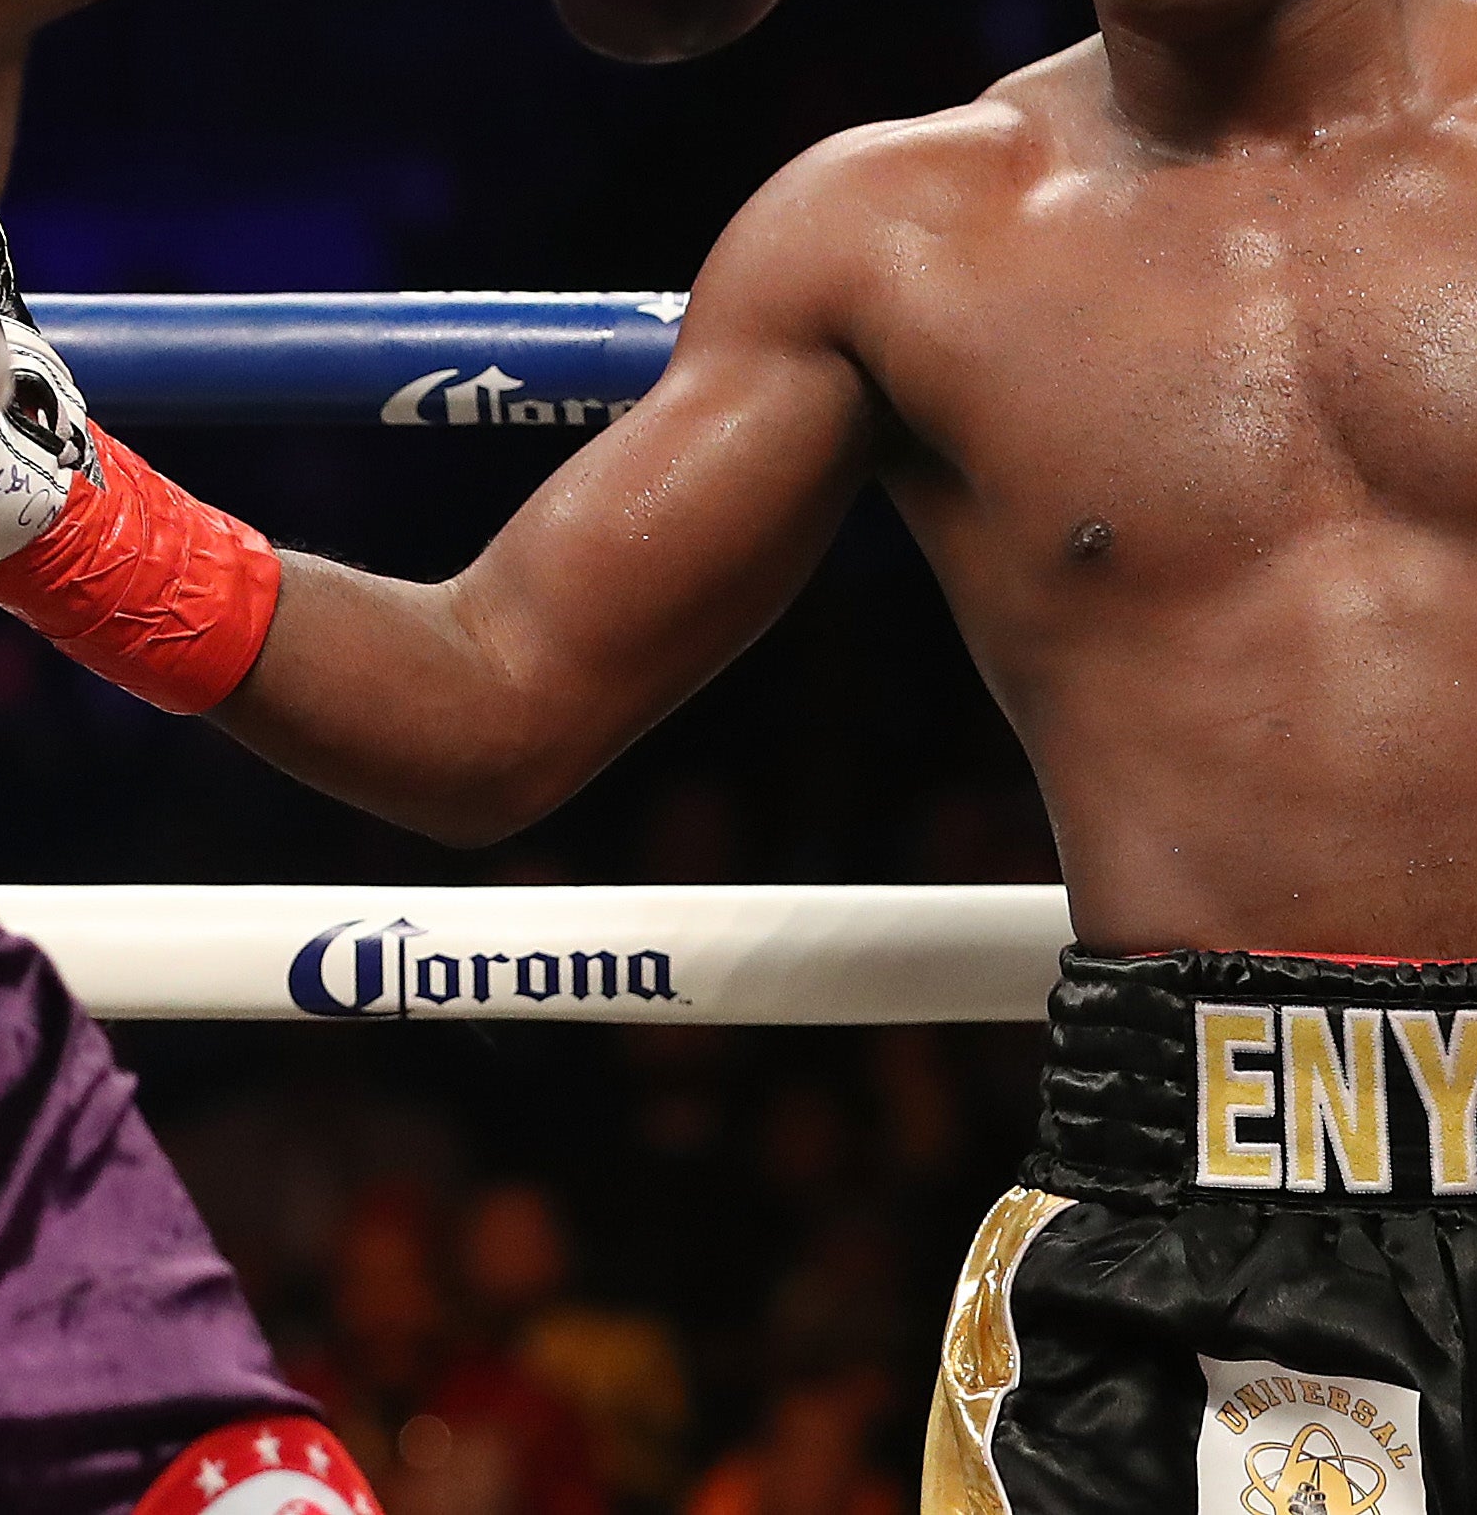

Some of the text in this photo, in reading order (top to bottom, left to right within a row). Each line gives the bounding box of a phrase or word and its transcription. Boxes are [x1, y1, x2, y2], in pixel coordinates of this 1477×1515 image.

[380, 364, 639, 426] Cor
[287, 916, 678, 1019] Corona
[1215, 1376, 1412, 1470] UNIVERSAL
